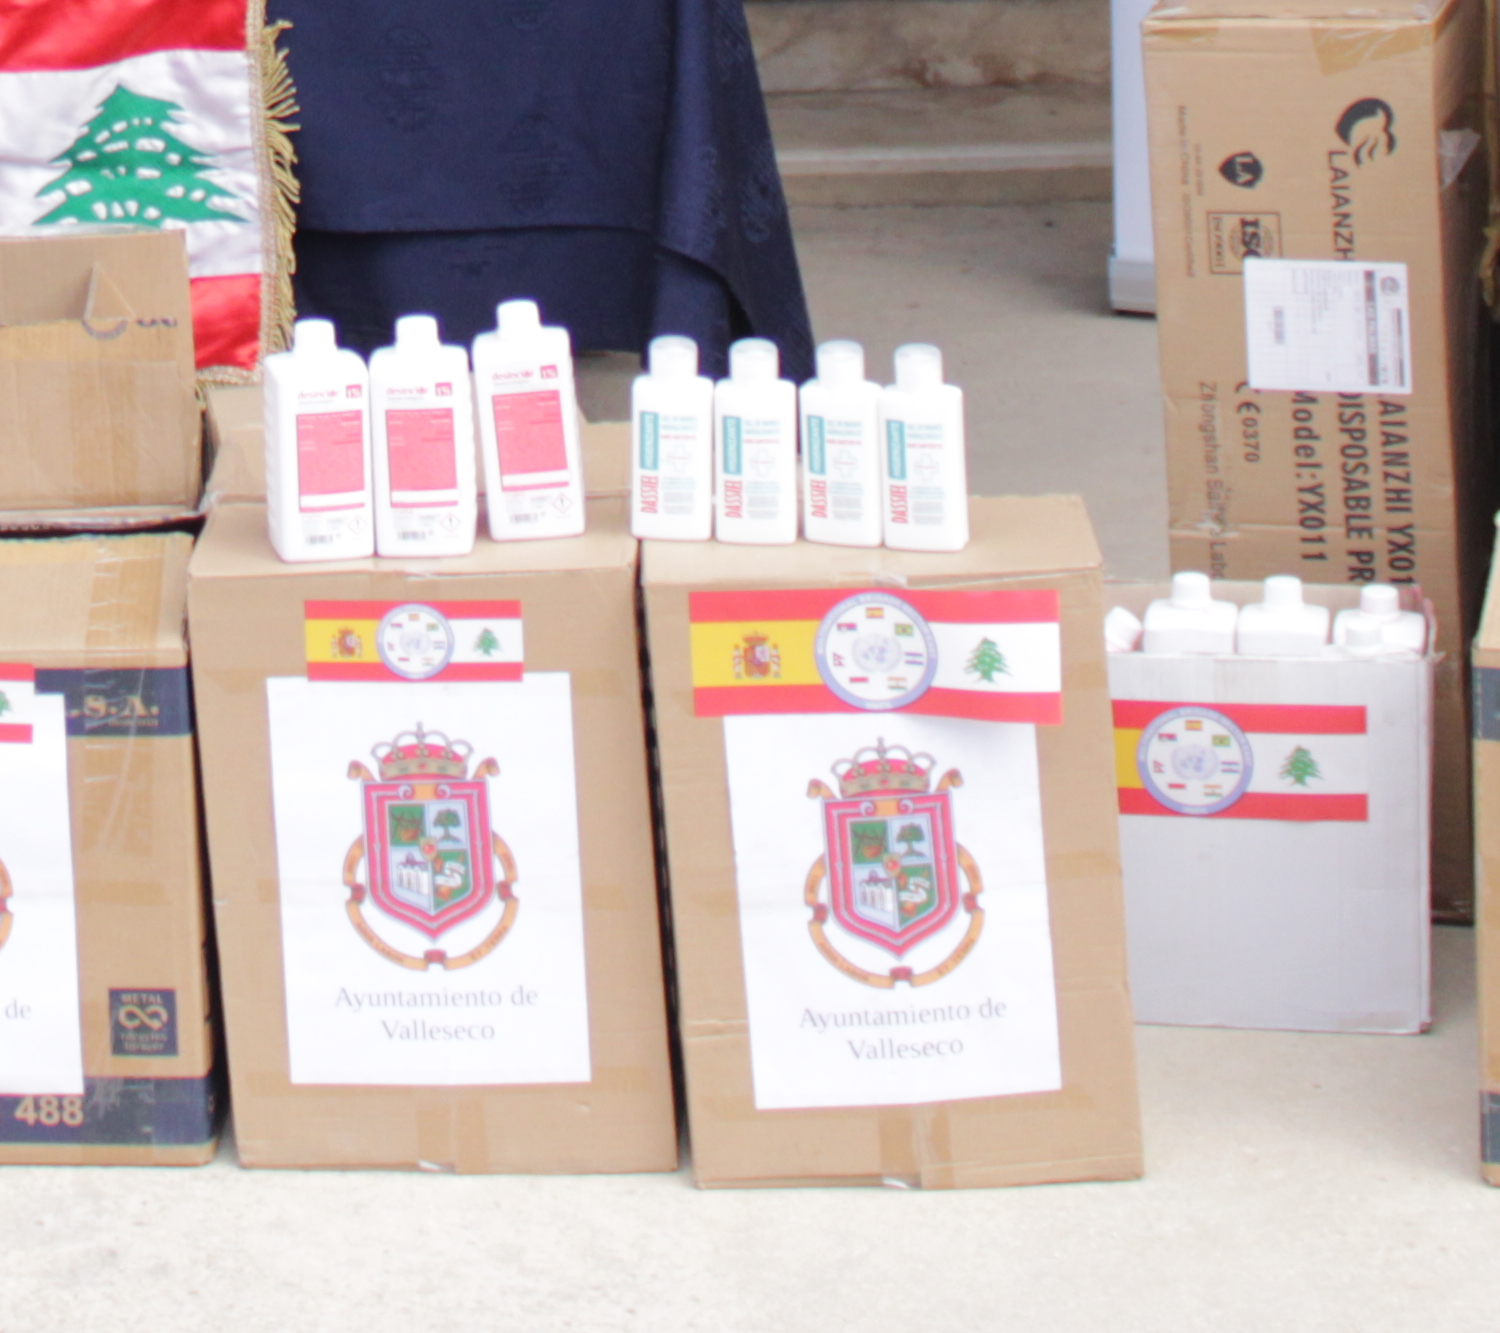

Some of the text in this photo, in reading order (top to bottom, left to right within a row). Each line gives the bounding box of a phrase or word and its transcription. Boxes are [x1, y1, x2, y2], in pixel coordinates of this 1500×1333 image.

[1328, 149, 1356, 261] LAIANZH
[1378, 393, 1414, 513] AIANZHI
[4, 998, 32, 1020] de
[120, 992, 163, 1005] METAL
[334, 985, 539, 1013] Ayuntamiento de
[799, 998, 1007, 1031] Ayuntamiento de
[380, 1018, 496, 1042] Valleseco
[846, 1037, 964, 1062] Valleseco
[14, 1094, 85, 1127] 488
